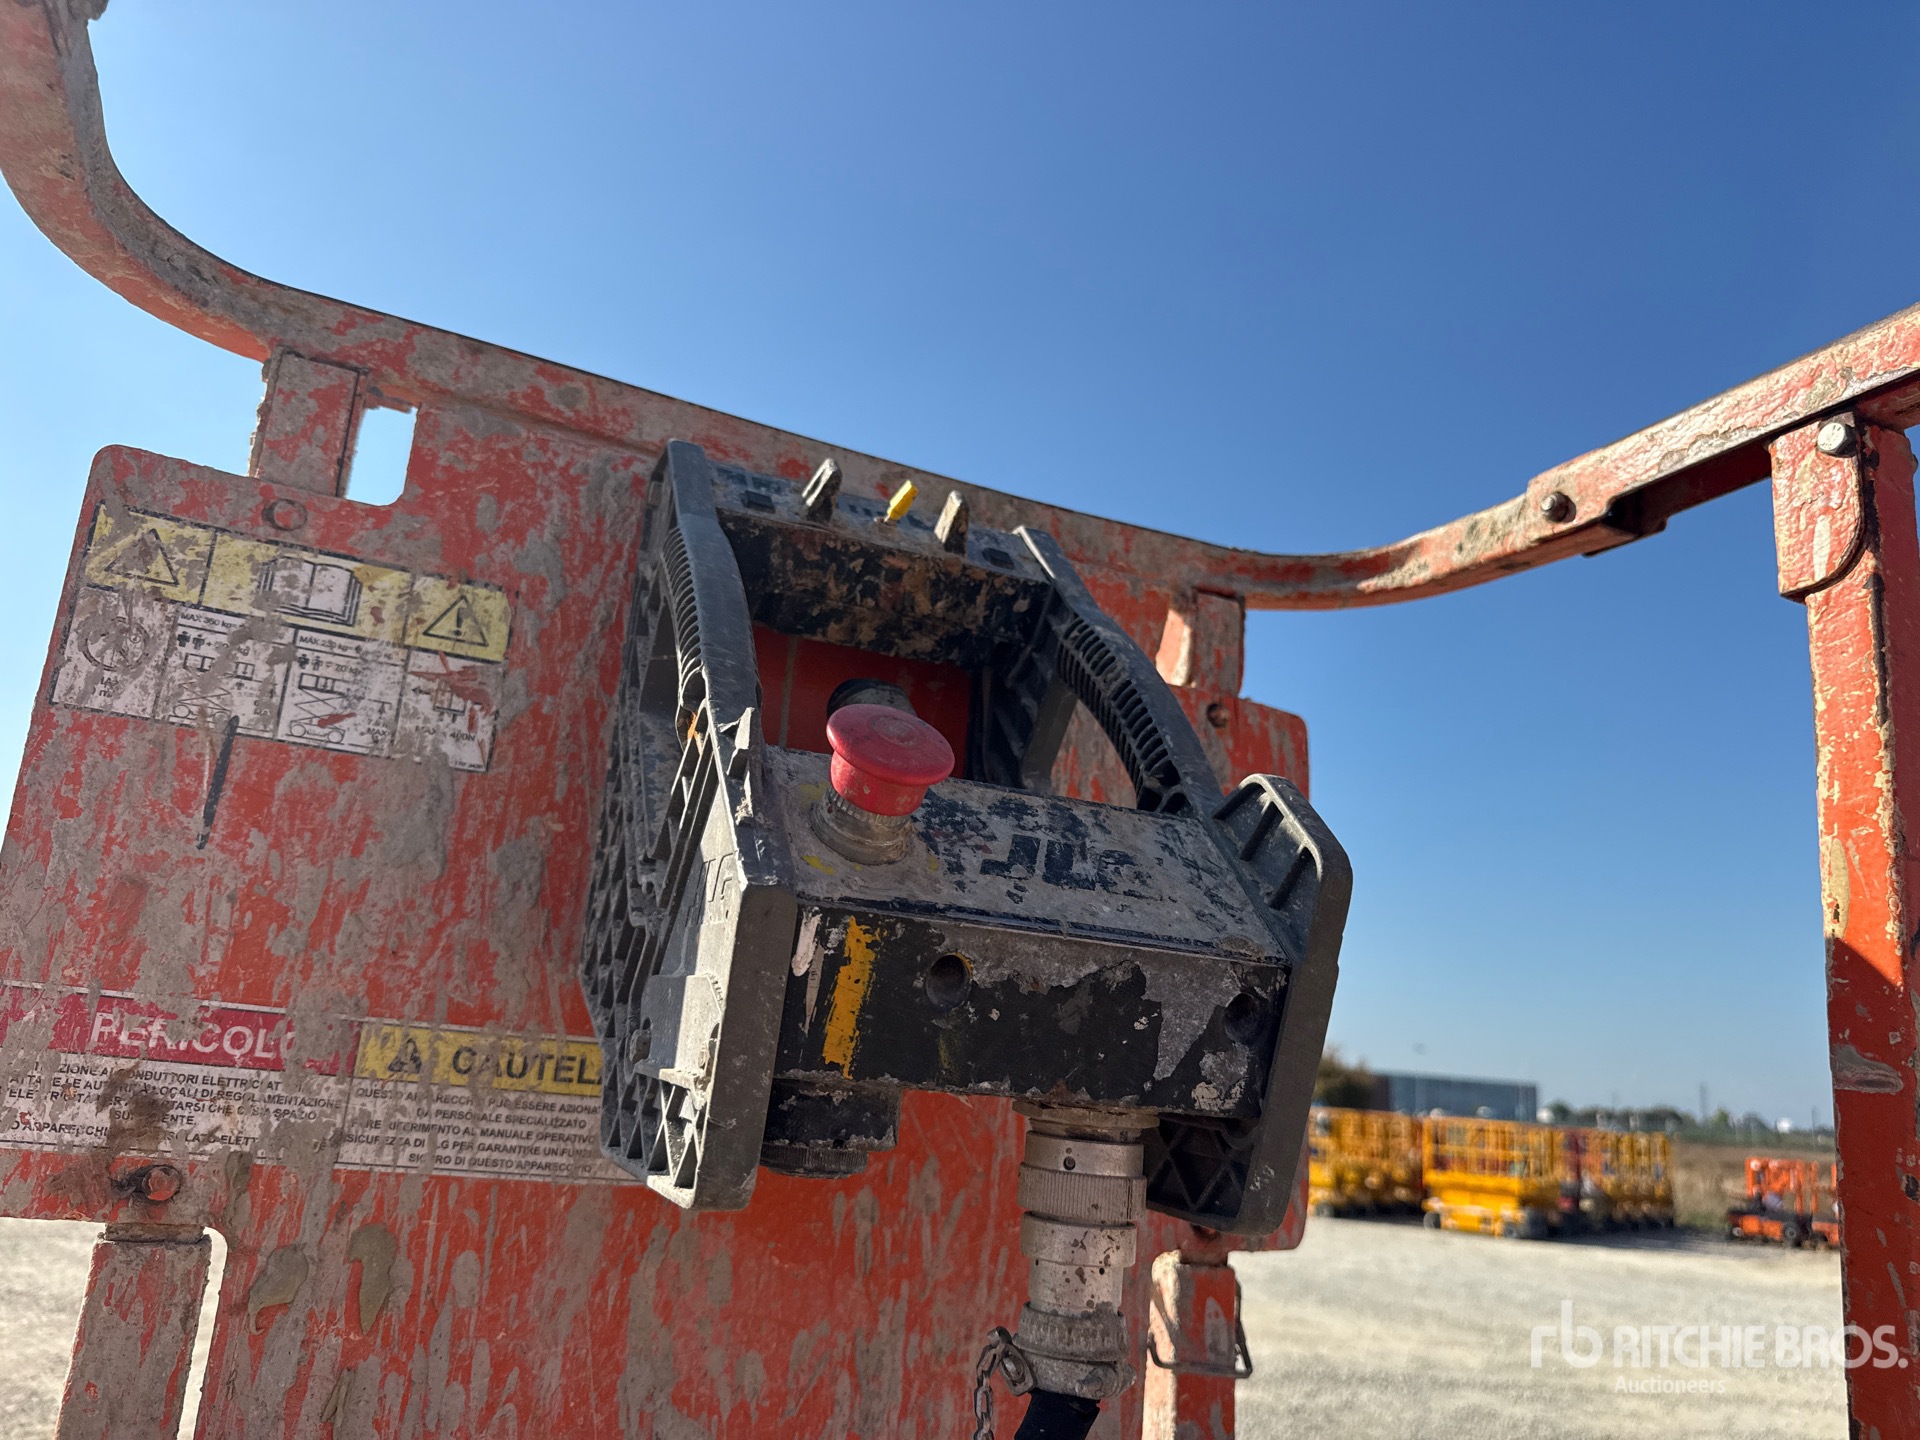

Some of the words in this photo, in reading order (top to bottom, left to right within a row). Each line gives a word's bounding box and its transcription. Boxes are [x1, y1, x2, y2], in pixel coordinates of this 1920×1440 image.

[299, 635, 319, 645] MAX
[201, 1088, 213, 1098] DI
[480, 1127, 533, 1140] MANUALE
[413, 1138, 425, 1149] DI
